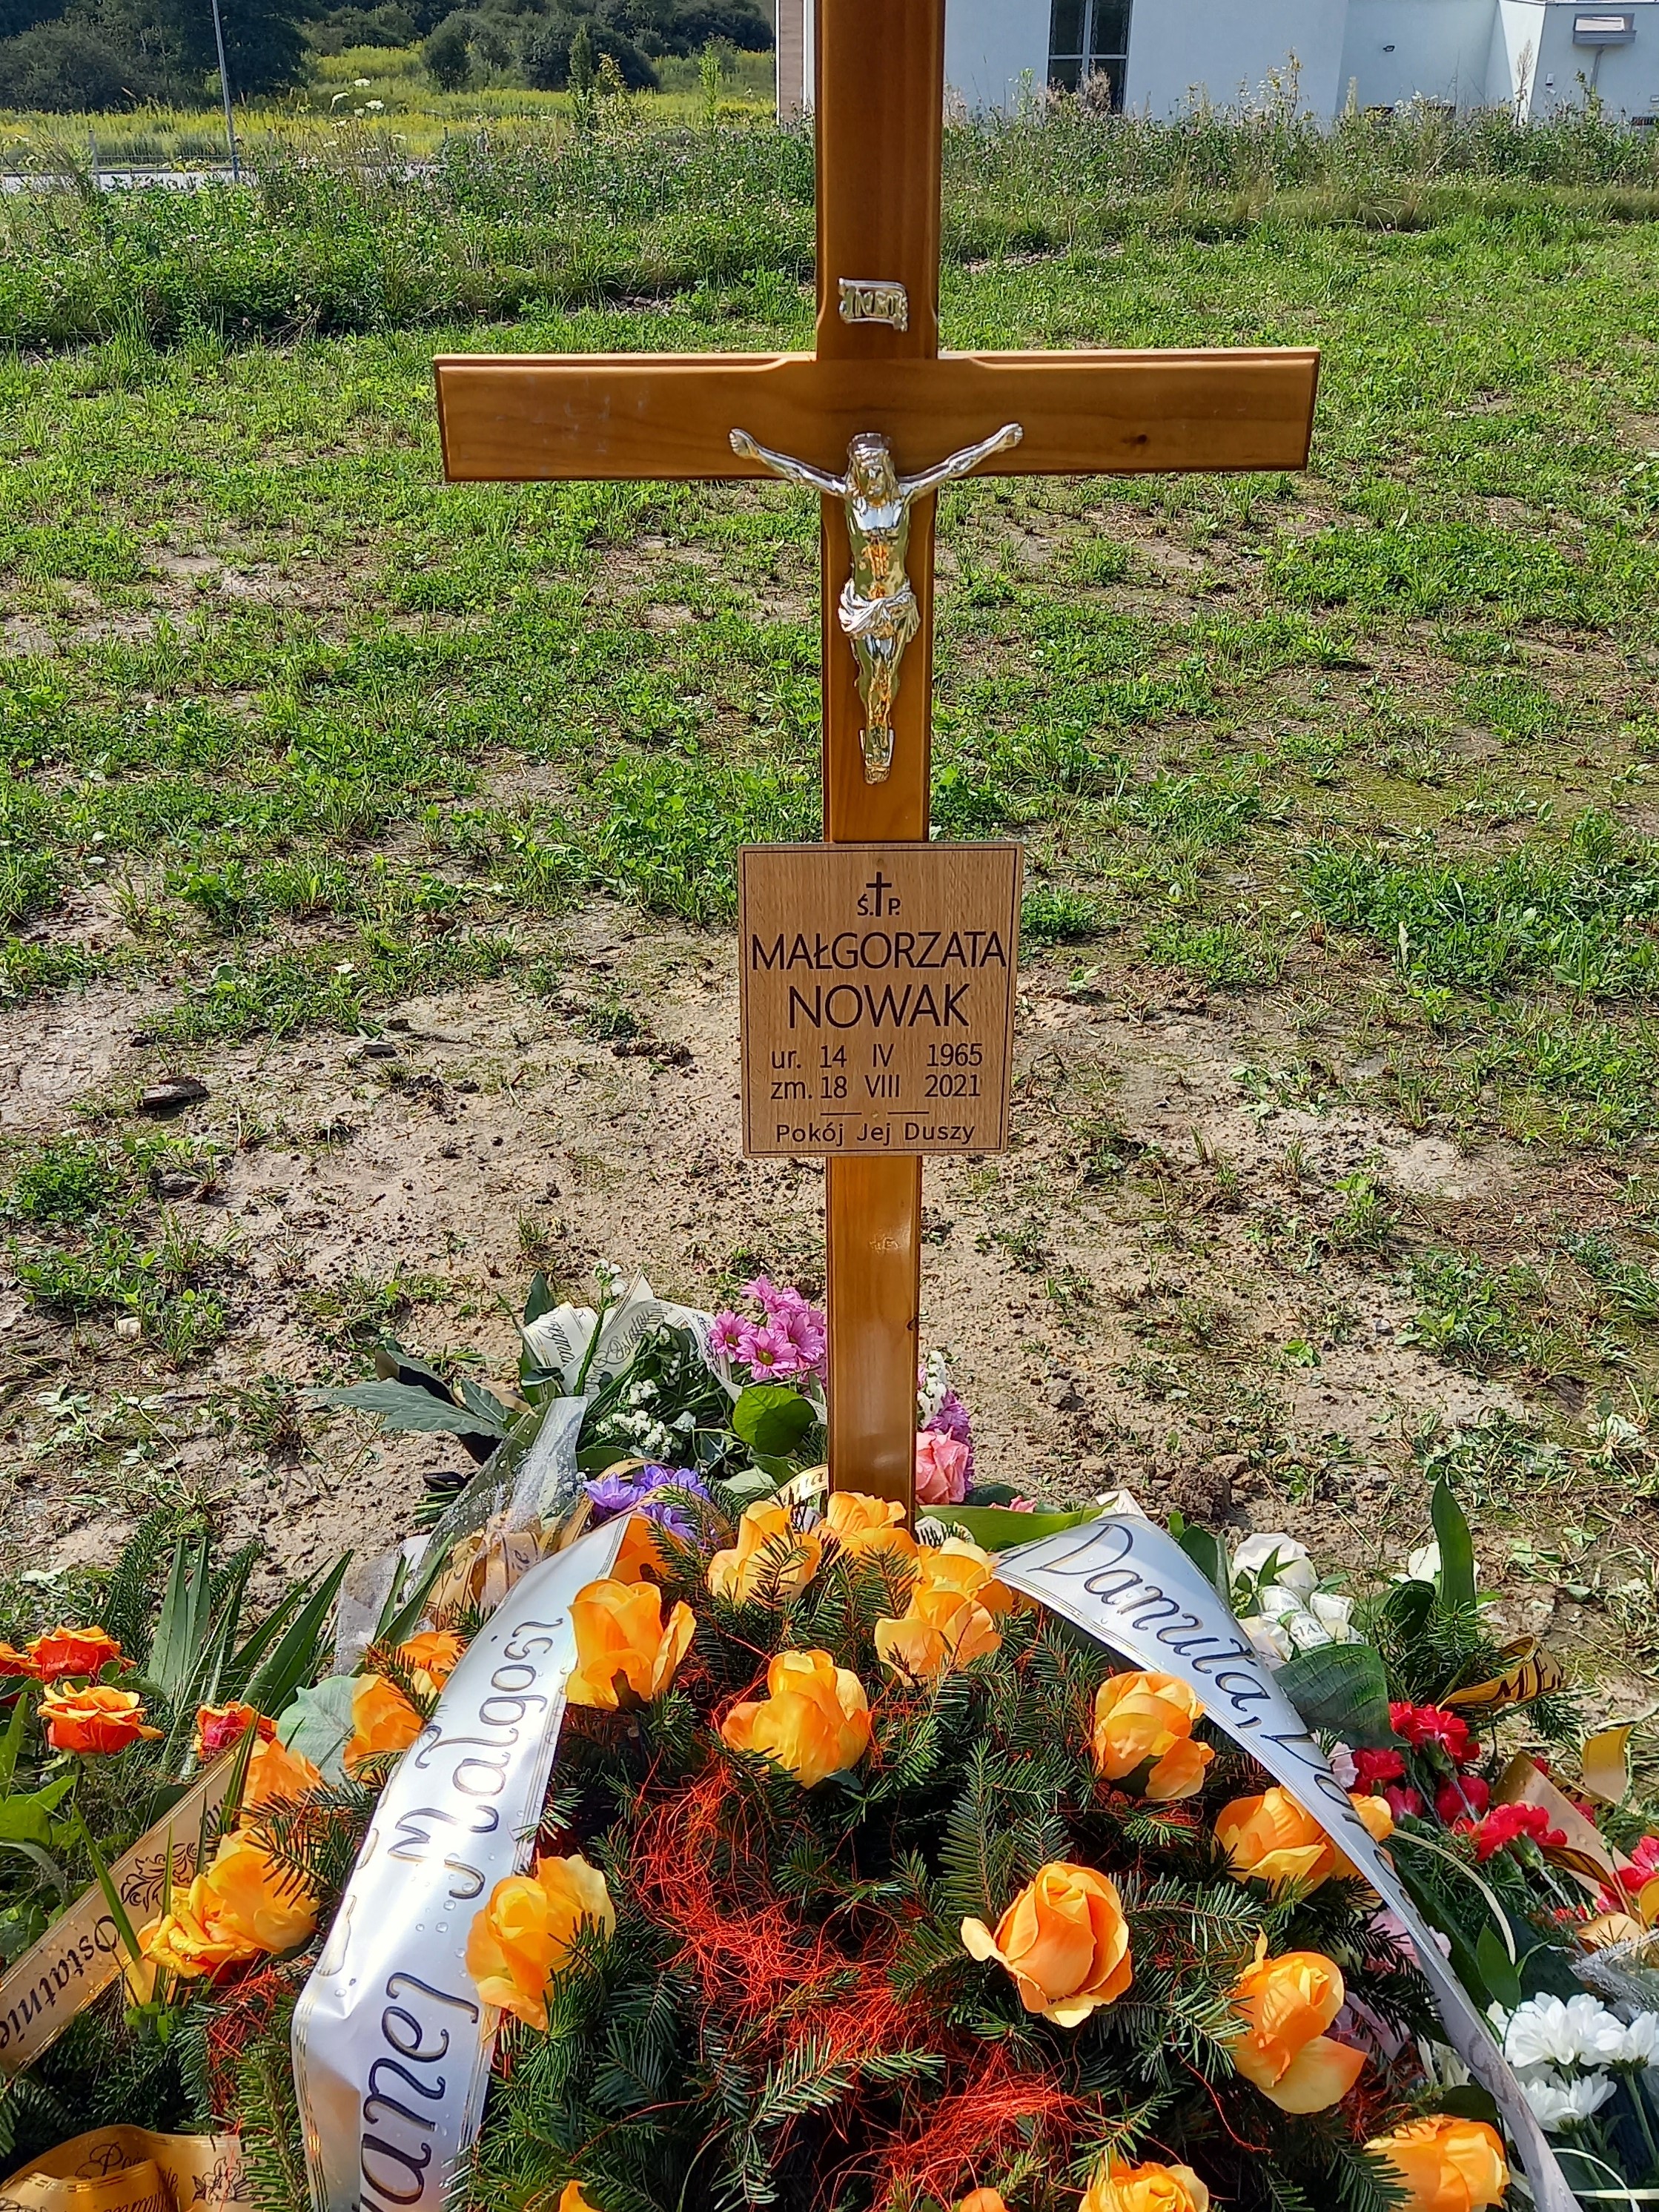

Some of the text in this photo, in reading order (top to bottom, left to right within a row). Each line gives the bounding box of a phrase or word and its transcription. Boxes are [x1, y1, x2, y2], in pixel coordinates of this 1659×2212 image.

[751, 930, 1007, 970] MAŁGORZATA
[788, 983, 971, 1029] NOWAK
[771, 1042, 984, 1070] ur. 14 IV 1965
[770, 1073, 981, 1100] zm. 18 VIII 2021
[776, 1122, 976, 1146] Pokój Jej Duszy
